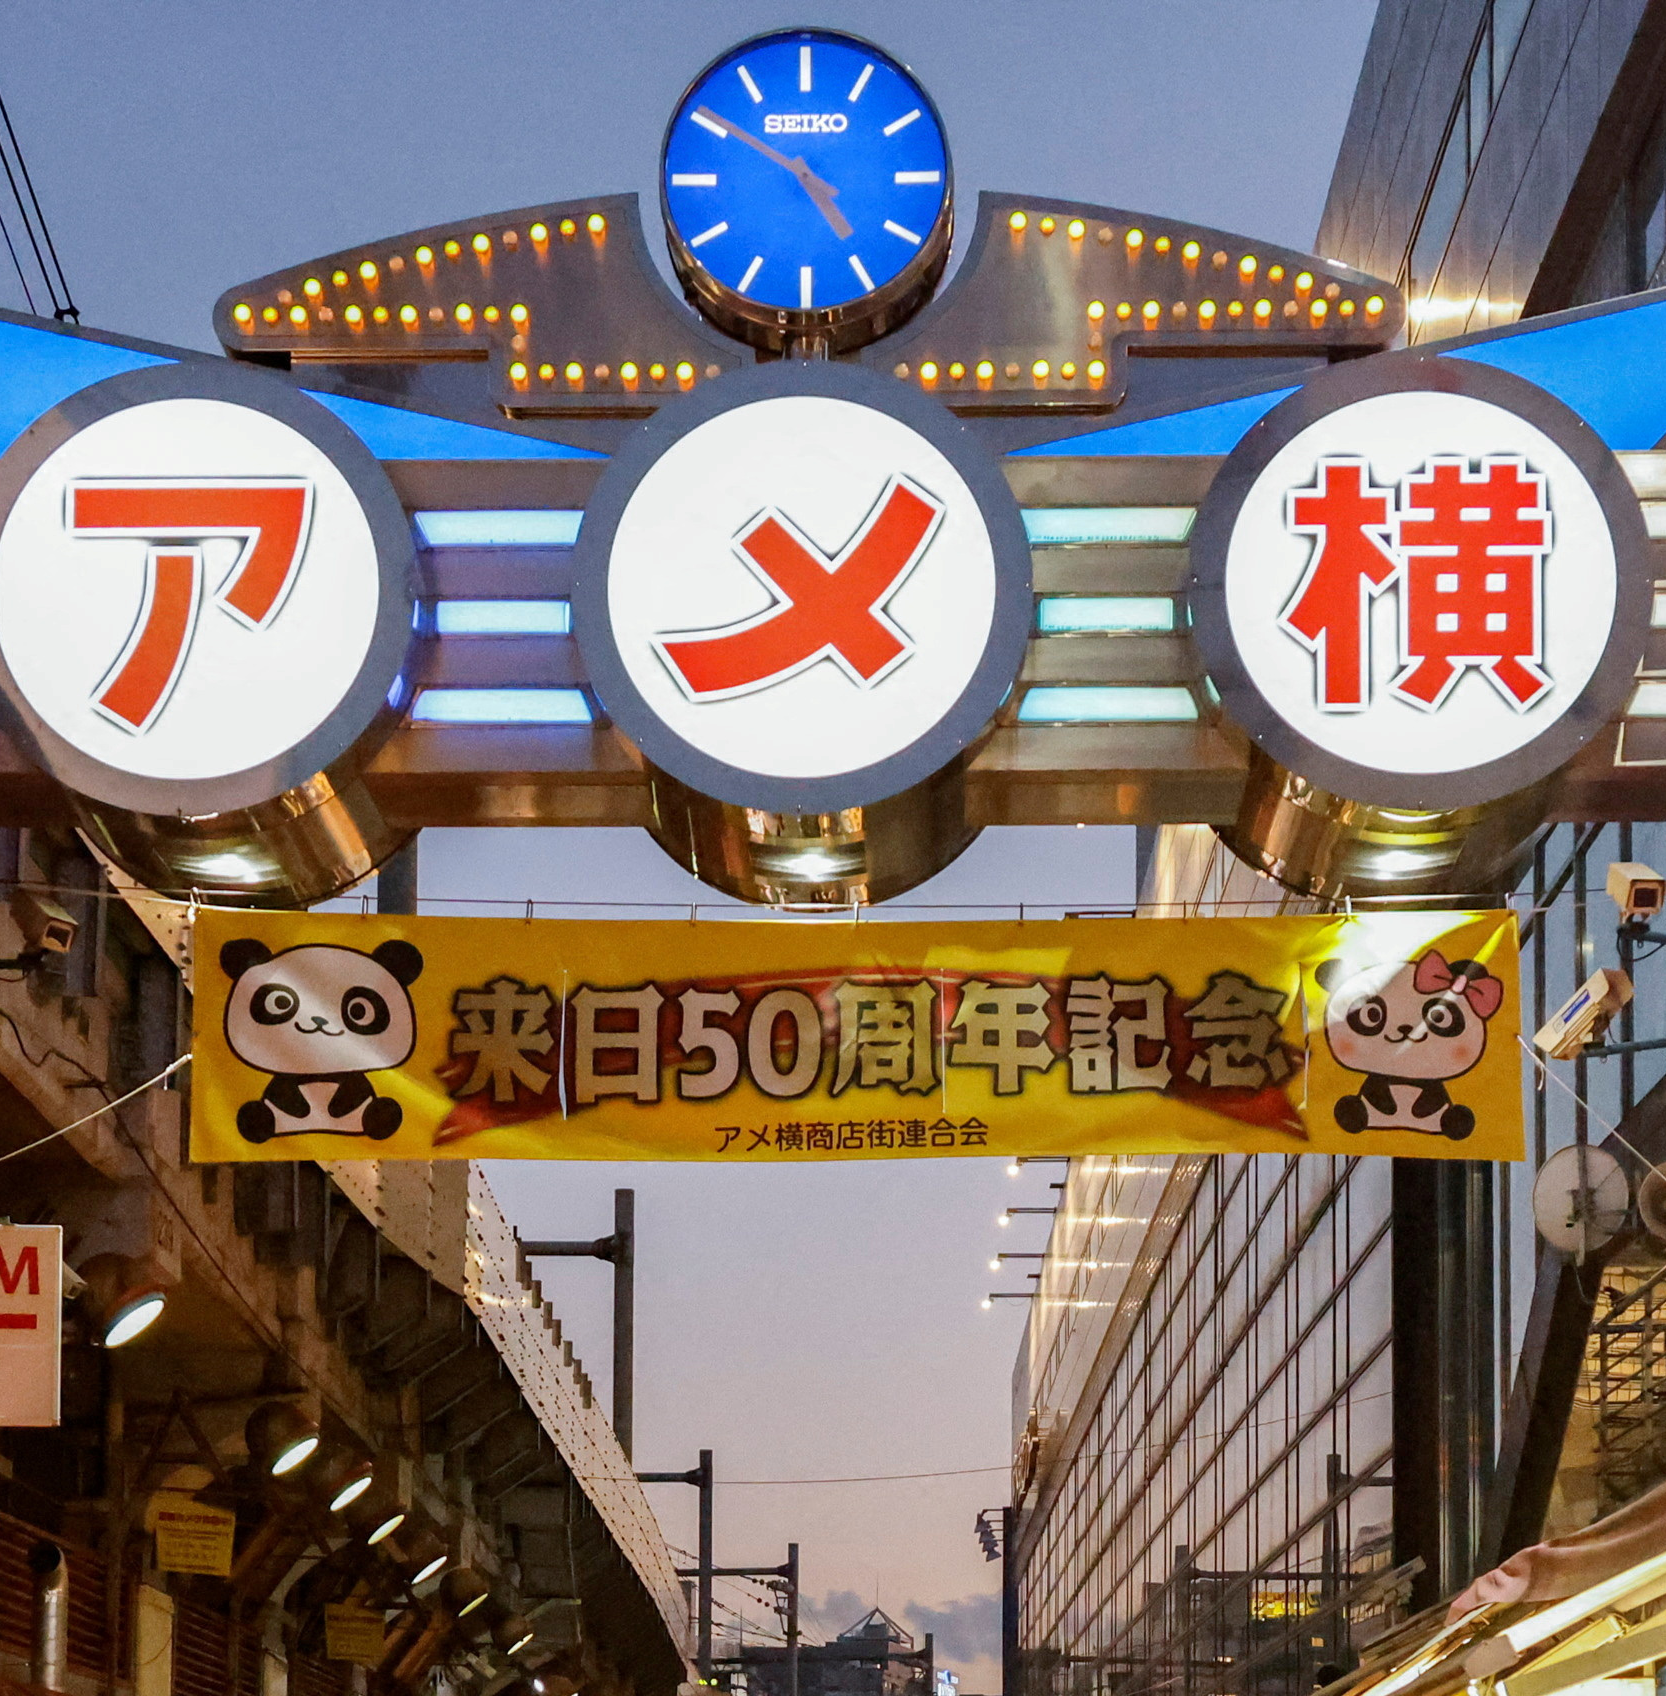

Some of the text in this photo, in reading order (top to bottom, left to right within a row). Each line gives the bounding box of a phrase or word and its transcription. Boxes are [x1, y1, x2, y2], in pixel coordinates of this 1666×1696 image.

[764, 114, 848, 133] SEIKO
[451, 972, 1295, 1104] 来日50周年記念
[714, 1116, 990, 1152] アメ横商店街連合会
